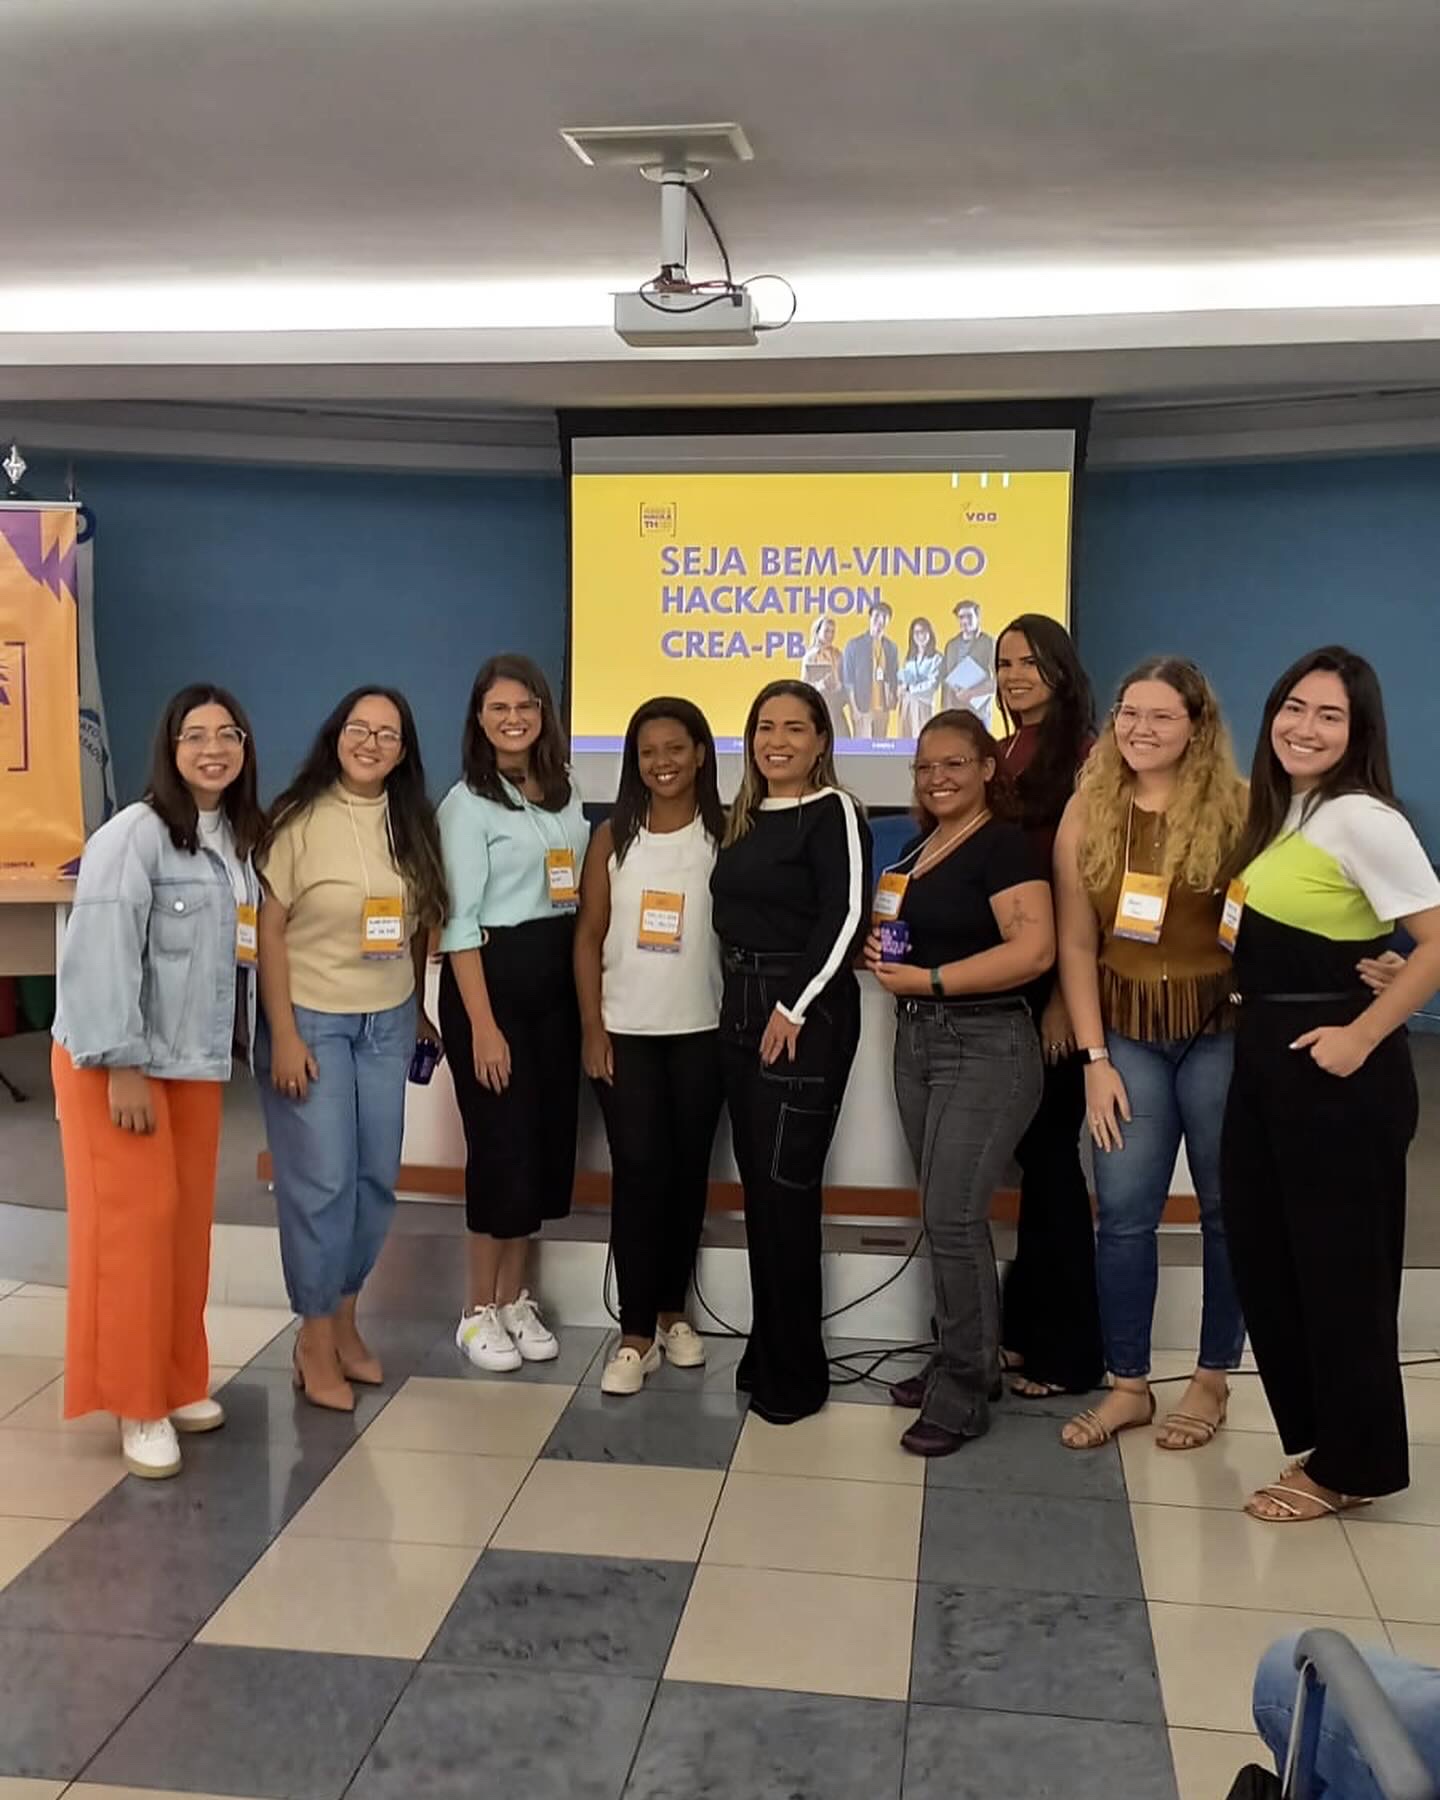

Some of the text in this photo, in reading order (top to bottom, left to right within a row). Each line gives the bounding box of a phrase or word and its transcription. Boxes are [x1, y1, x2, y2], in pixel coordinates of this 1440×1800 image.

[661, 546, 986, 576] SEJA BEM-VINDO
[662, 585, 881, 614] HACKATHON
[661, 631, 806, 659] CREA-PB
